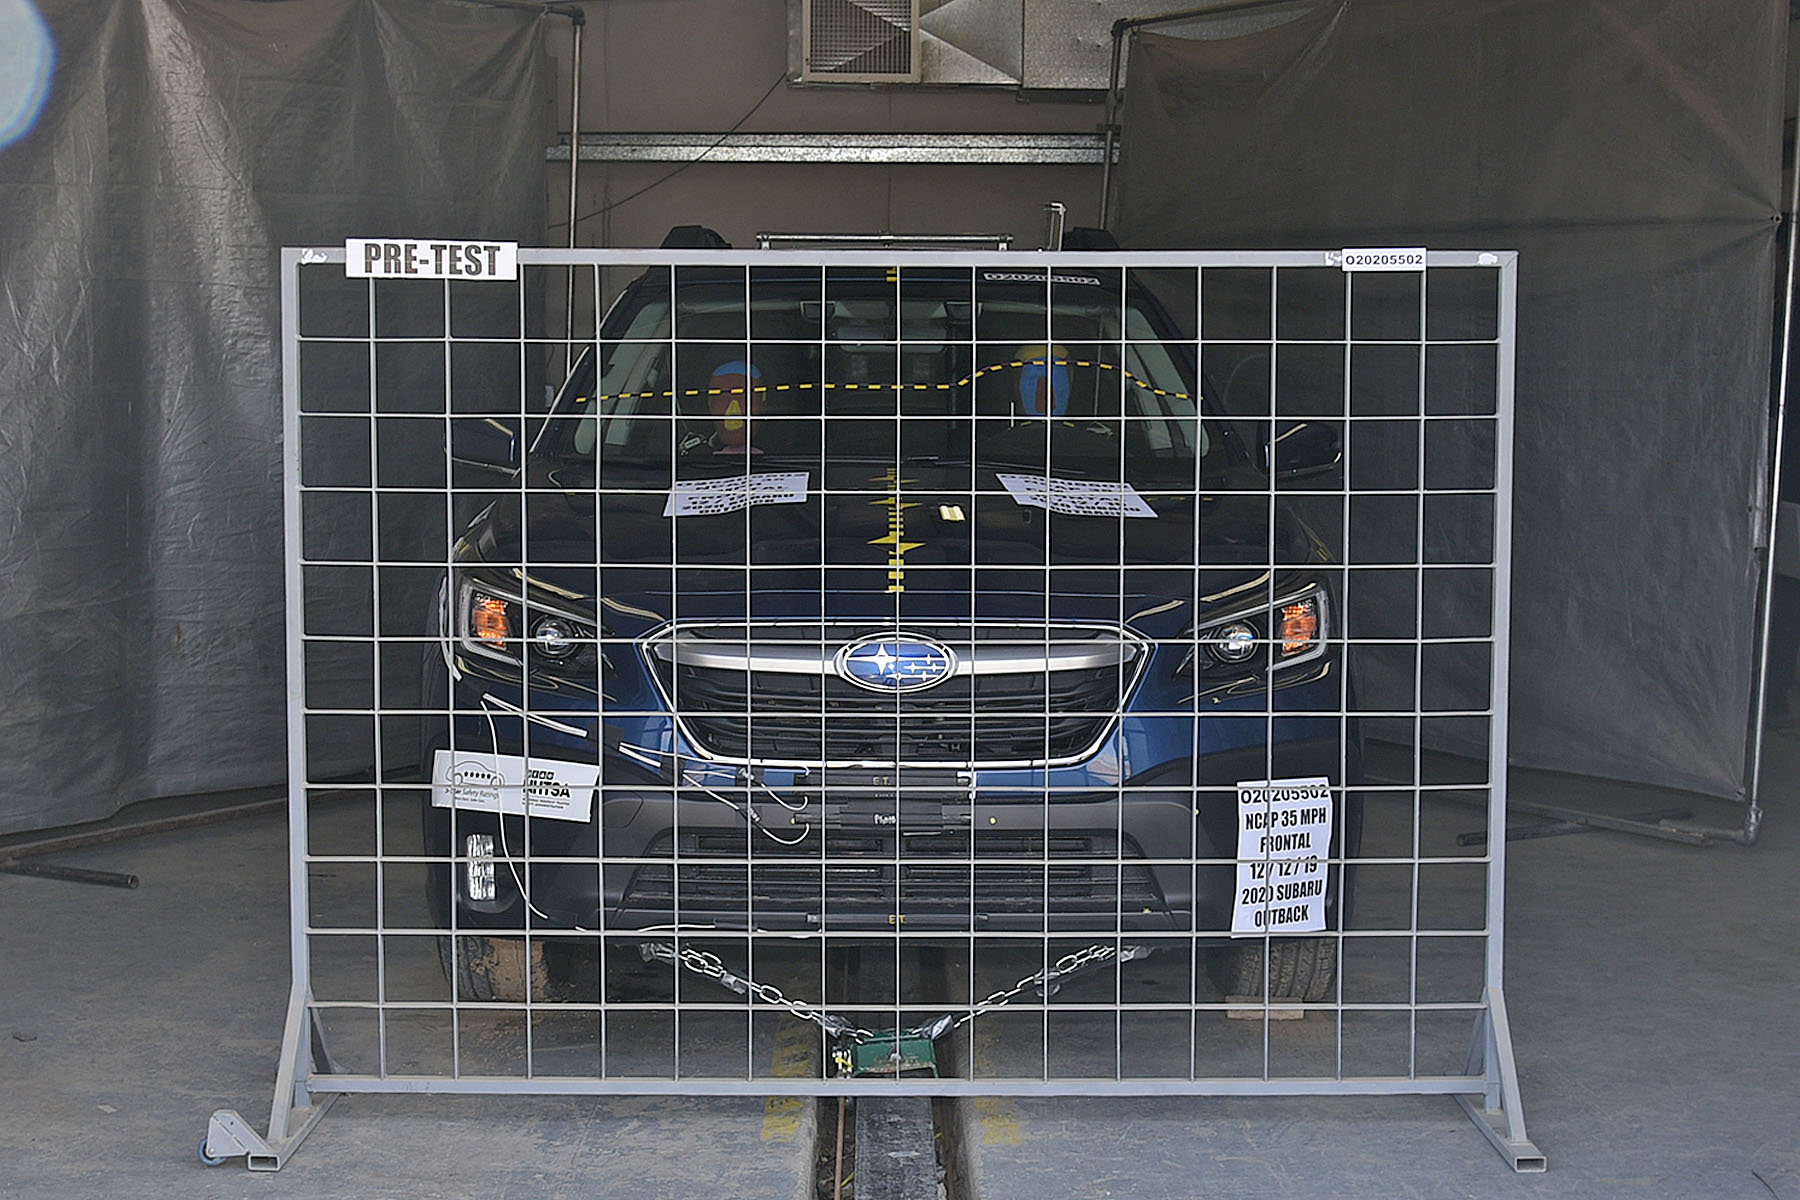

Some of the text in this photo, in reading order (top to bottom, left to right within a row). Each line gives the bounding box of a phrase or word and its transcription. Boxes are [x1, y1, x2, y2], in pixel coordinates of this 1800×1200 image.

[364, 243, 501, 276] PRE-TEST
[523, 779, 570, 798] NHTSA
[1245, 807, 1326, 830] NCAP 35 MPH
[1260, 832, 1311, 853] FRONTAL
[1241, 879, 1323, 905] 2020 SUBARU
[1254, 904, 1309, 928] OUTBACK
